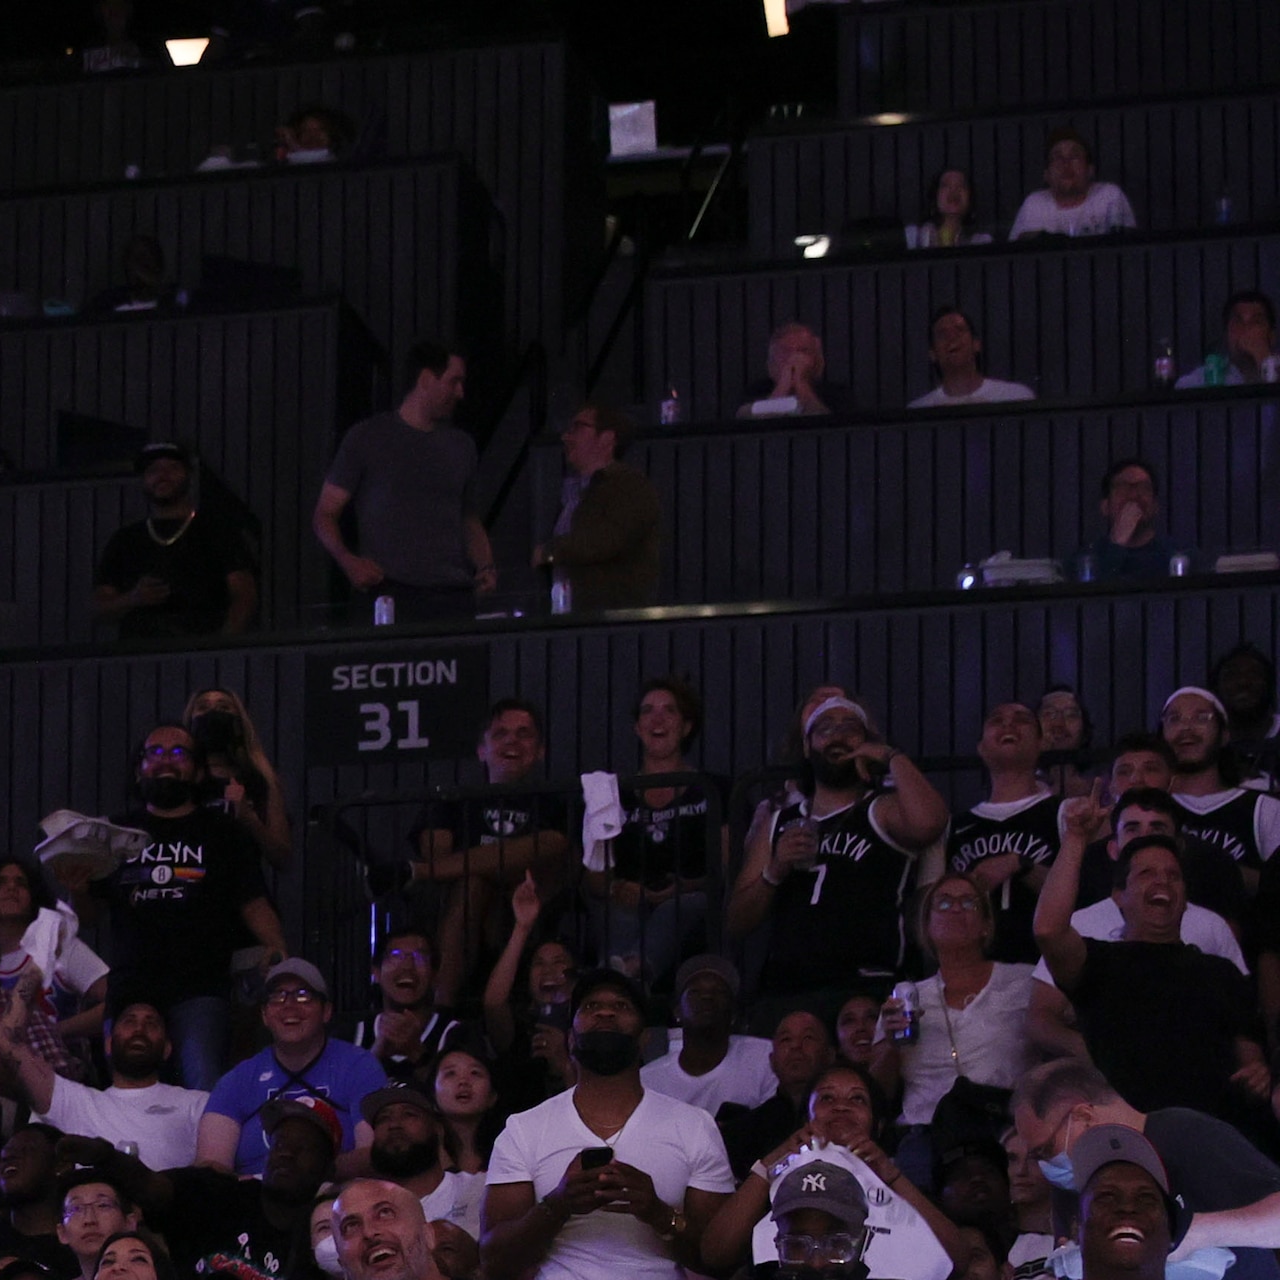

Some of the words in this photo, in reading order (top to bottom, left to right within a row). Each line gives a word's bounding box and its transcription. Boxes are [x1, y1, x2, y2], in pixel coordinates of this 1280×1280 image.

[331, 659, 458, 691] SECTION
[357, 699, 431, 752] 31
[950, 831, 1054, 873] BROOKLYN
[133, 886, 186, 903] NETS
[808, 863, 828, 906] 7
